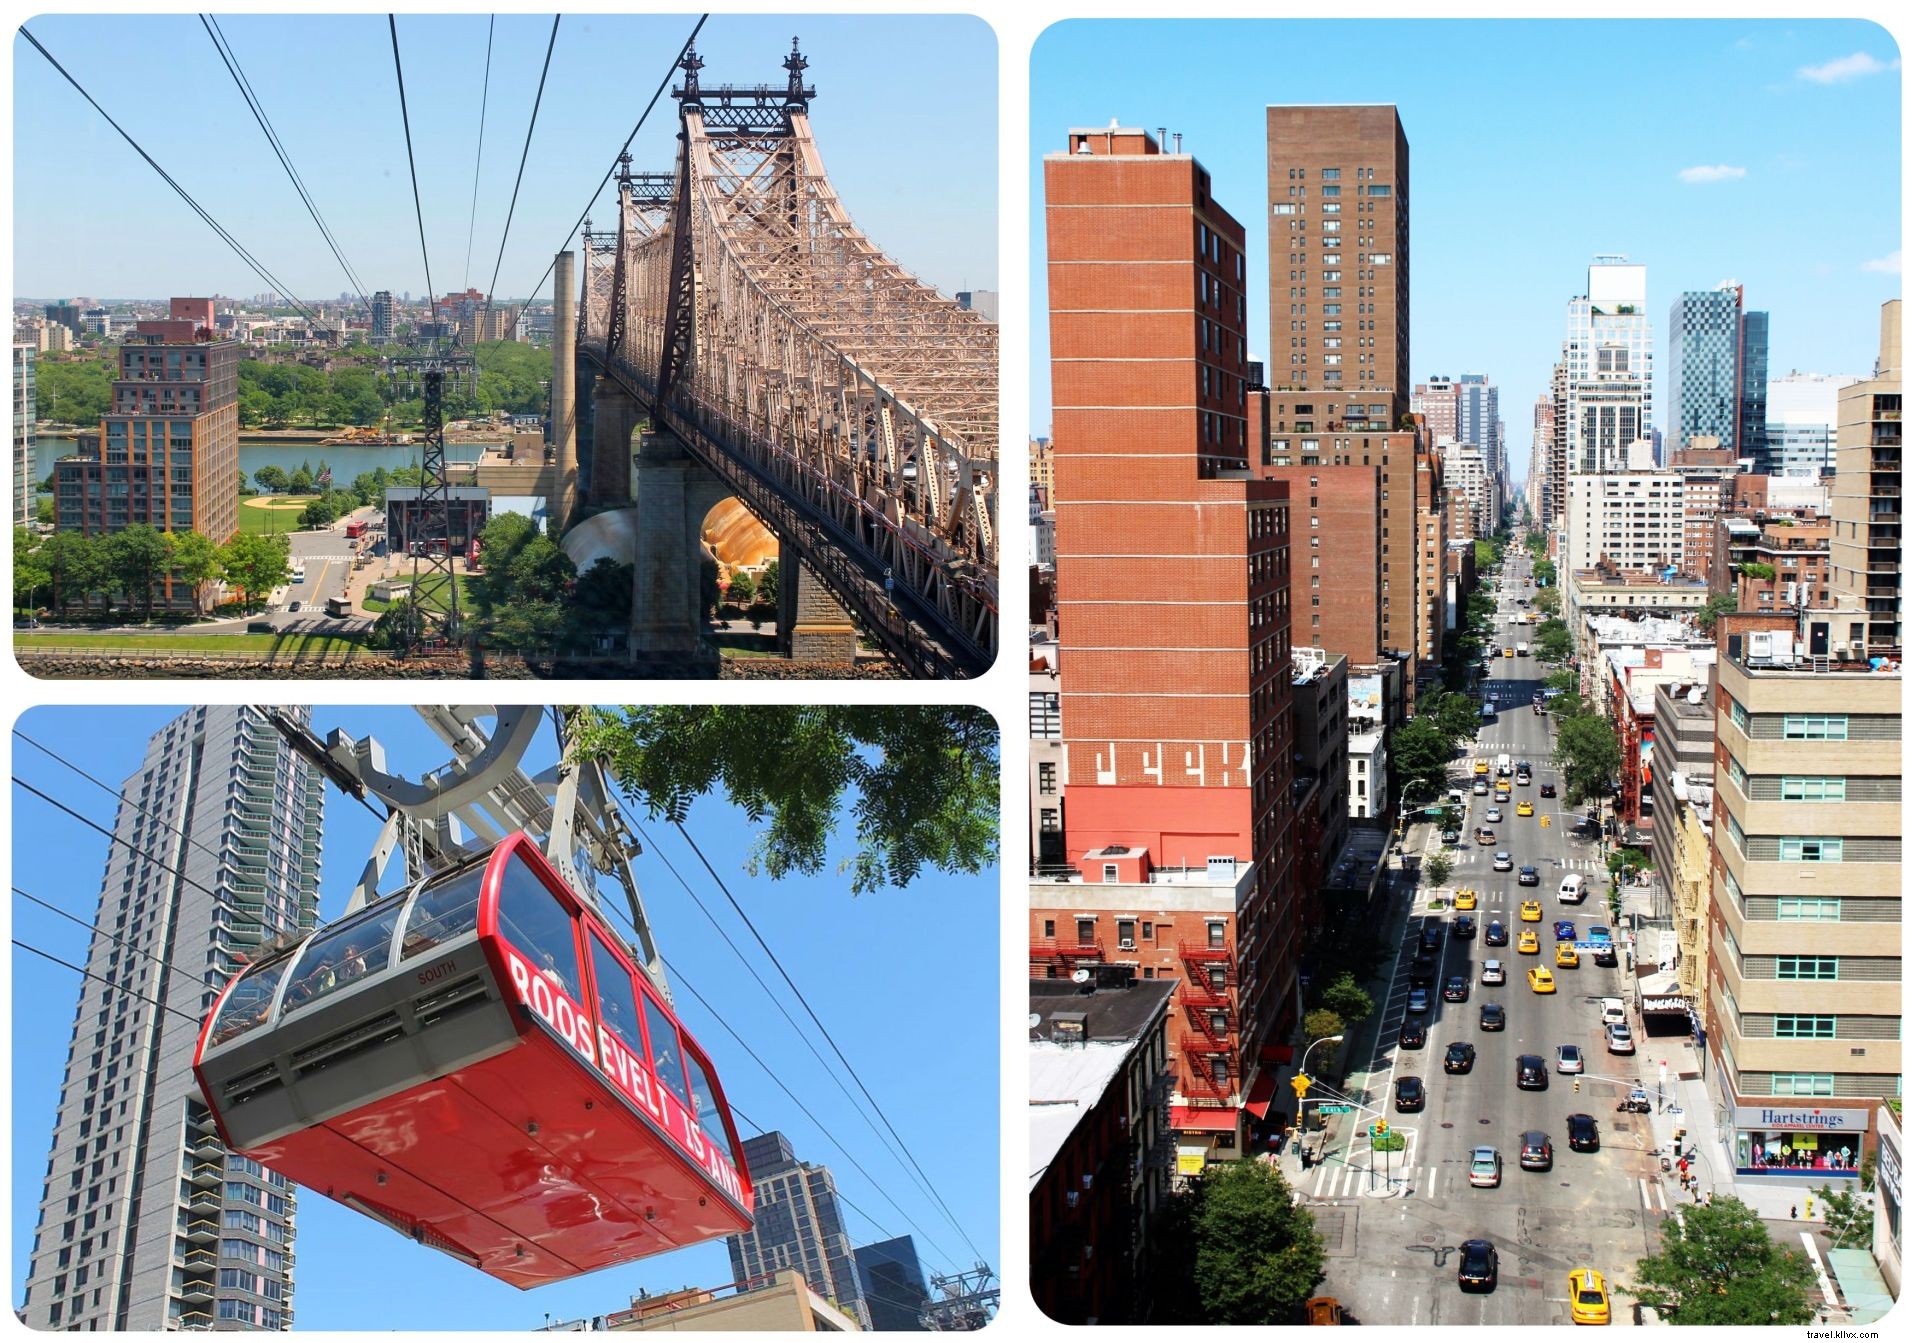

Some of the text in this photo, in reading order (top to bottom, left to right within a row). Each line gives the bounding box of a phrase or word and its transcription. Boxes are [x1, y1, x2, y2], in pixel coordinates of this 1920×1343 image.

[417, 960, 457, 985] SOUTH
[509, 951, 670, 1127] ROOSEVELT
[1762, 1110, 1844, 1128] Hartstrings
